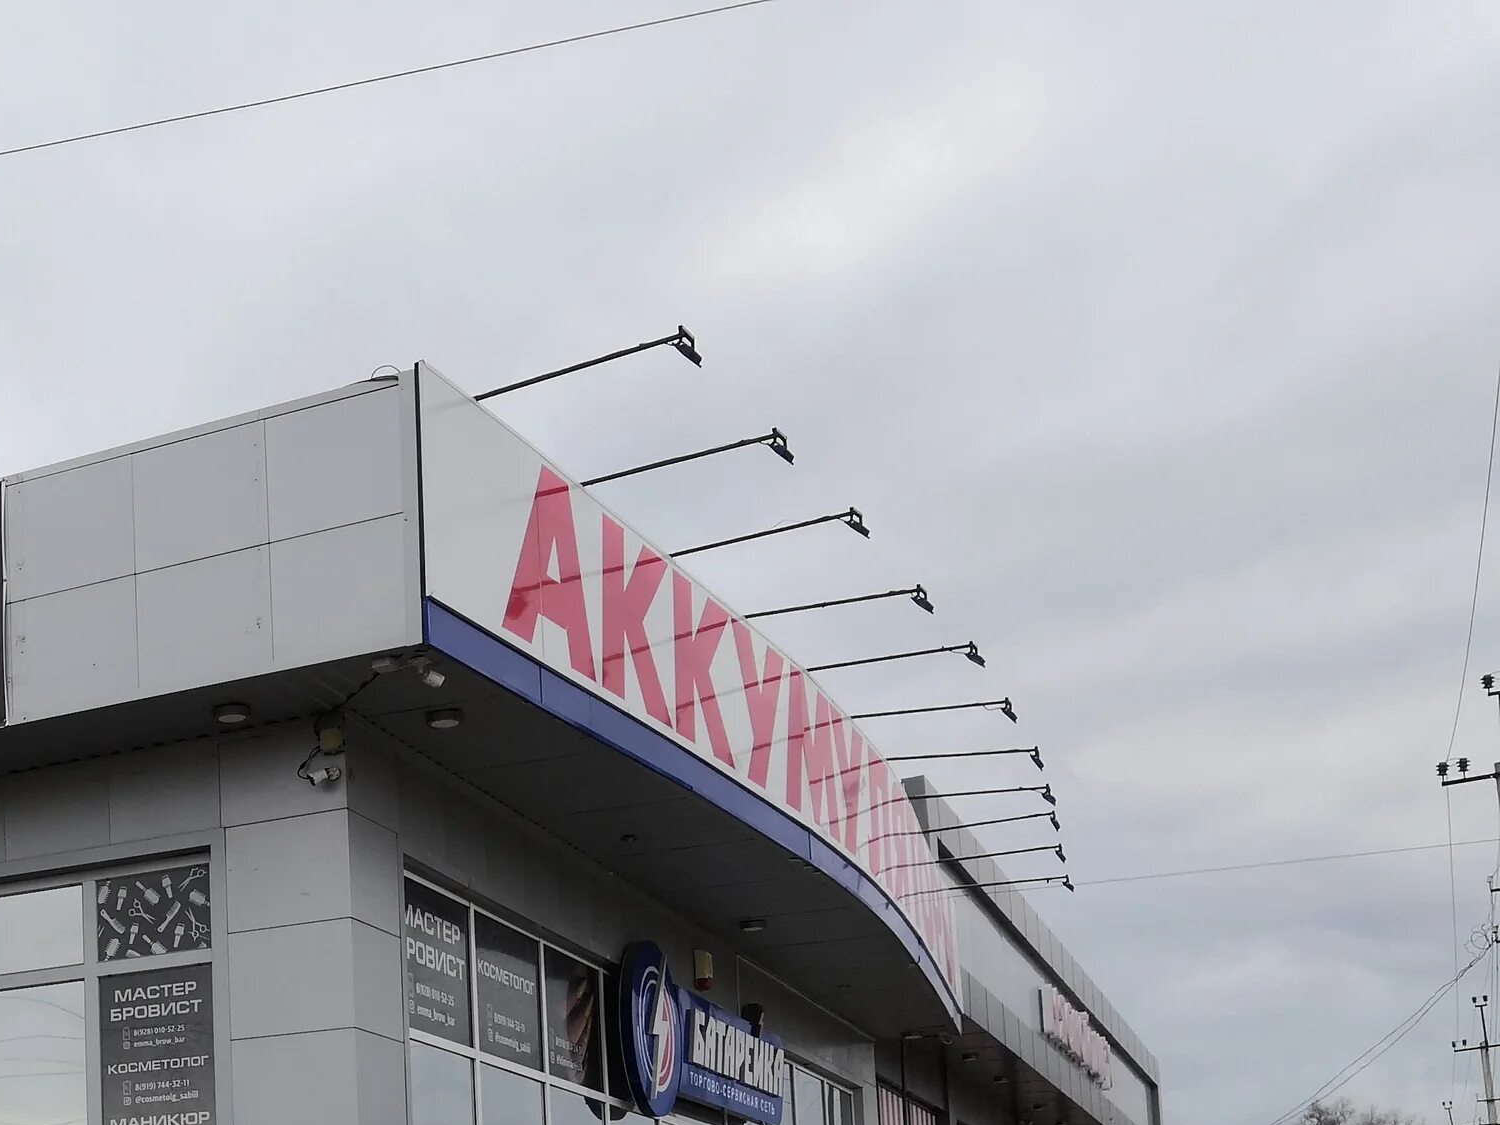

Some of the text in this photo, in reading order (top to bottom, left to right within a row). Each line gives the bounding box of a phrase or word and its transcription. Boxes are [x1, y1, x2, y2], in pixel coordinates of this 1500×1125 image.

[478, 958, 535, 995] КОСМЕТОЛОГ
[114, 981, 197, 1003] МАСТЕР
[110, 999, 202, 1021] БРОВИСТ
[692, 1008, 785, 1098] БАТАРЕЙКА
[107, 1055, 209, 1075] КОСМЕТОЛОГ
[760, 1099, 776, 1115] СЕТЬ
